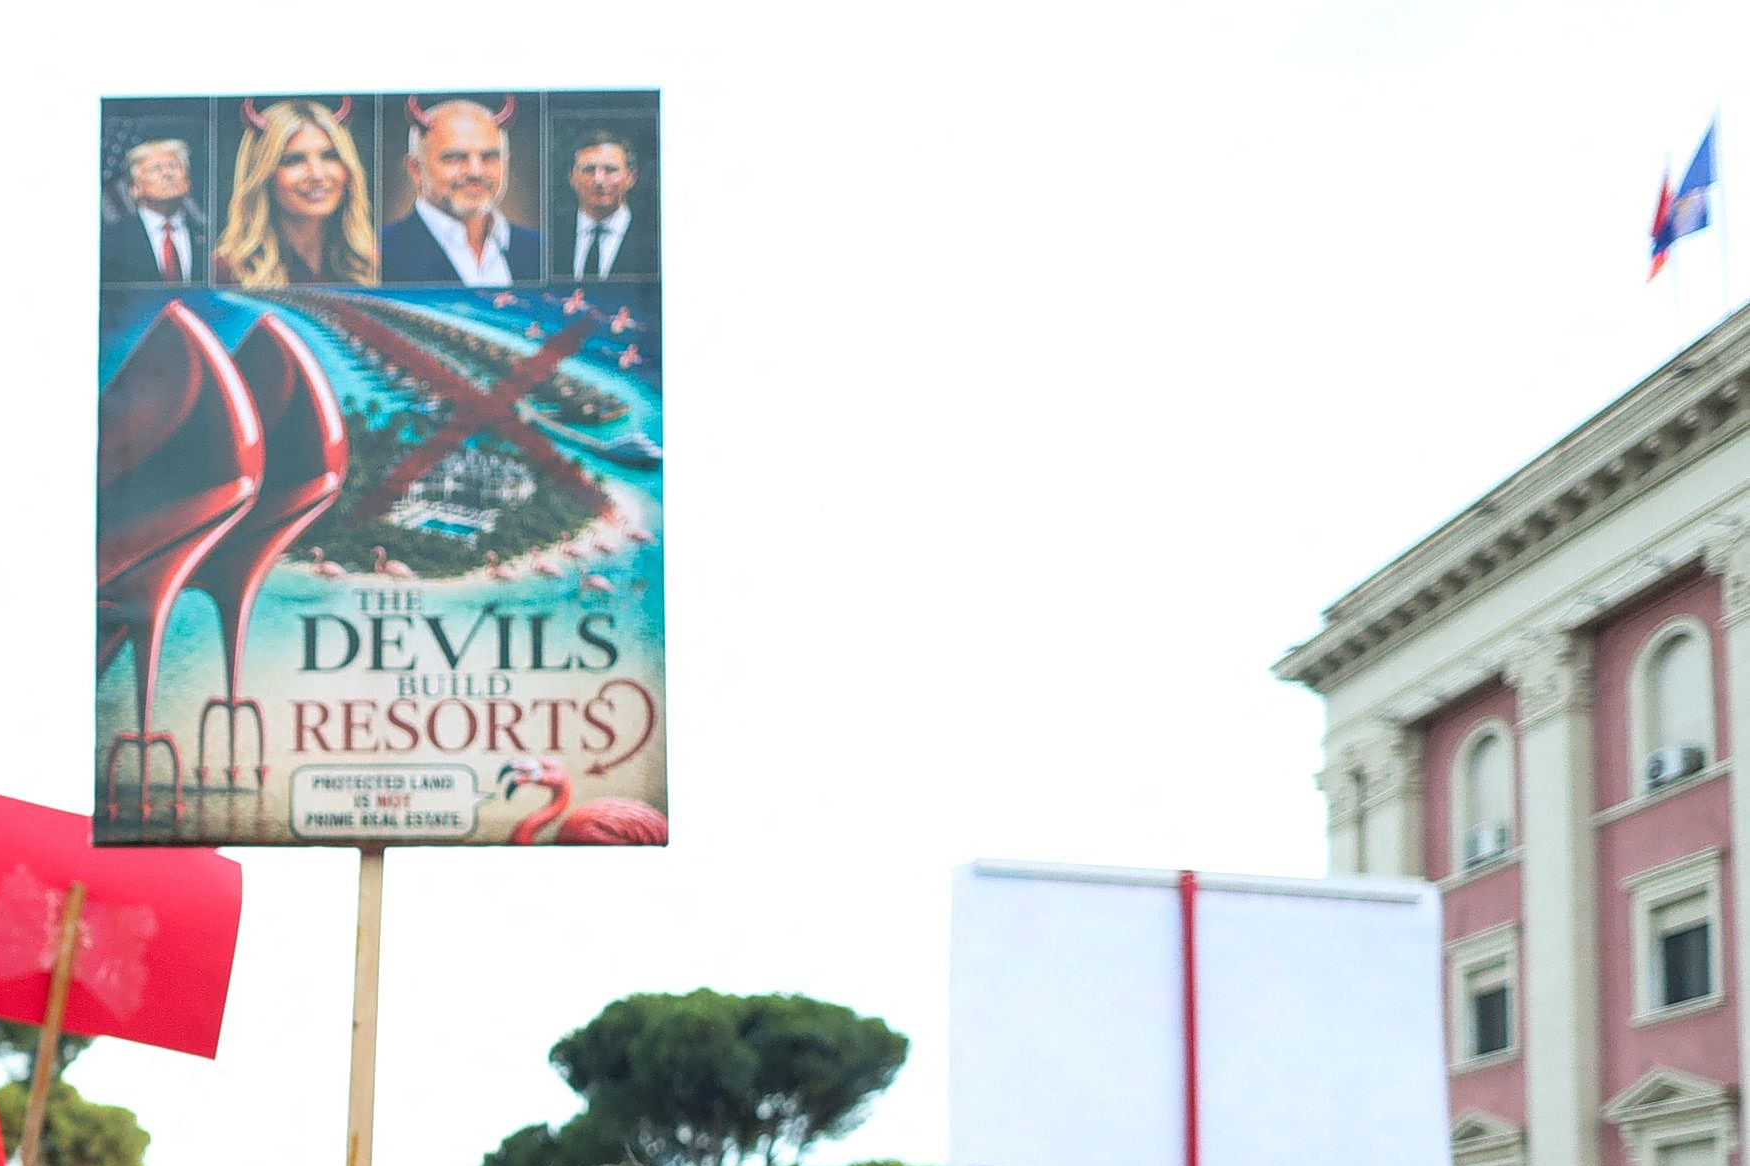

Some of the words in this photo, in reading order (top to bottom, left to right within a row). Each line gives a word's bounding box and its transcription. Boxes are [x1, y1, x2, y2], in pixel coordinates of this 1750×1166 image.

[354, 589, 422, 612] THE
[297, 602, 619, 672] DEVILS
[396, 673, 512, 699] BUILD
[289, 698, 620, 754] RESORTS
[312, 775, 406, 790] PROTECTED
[410, 775, 455, 790] LAND
[376, 793, 411, 808] NOT
